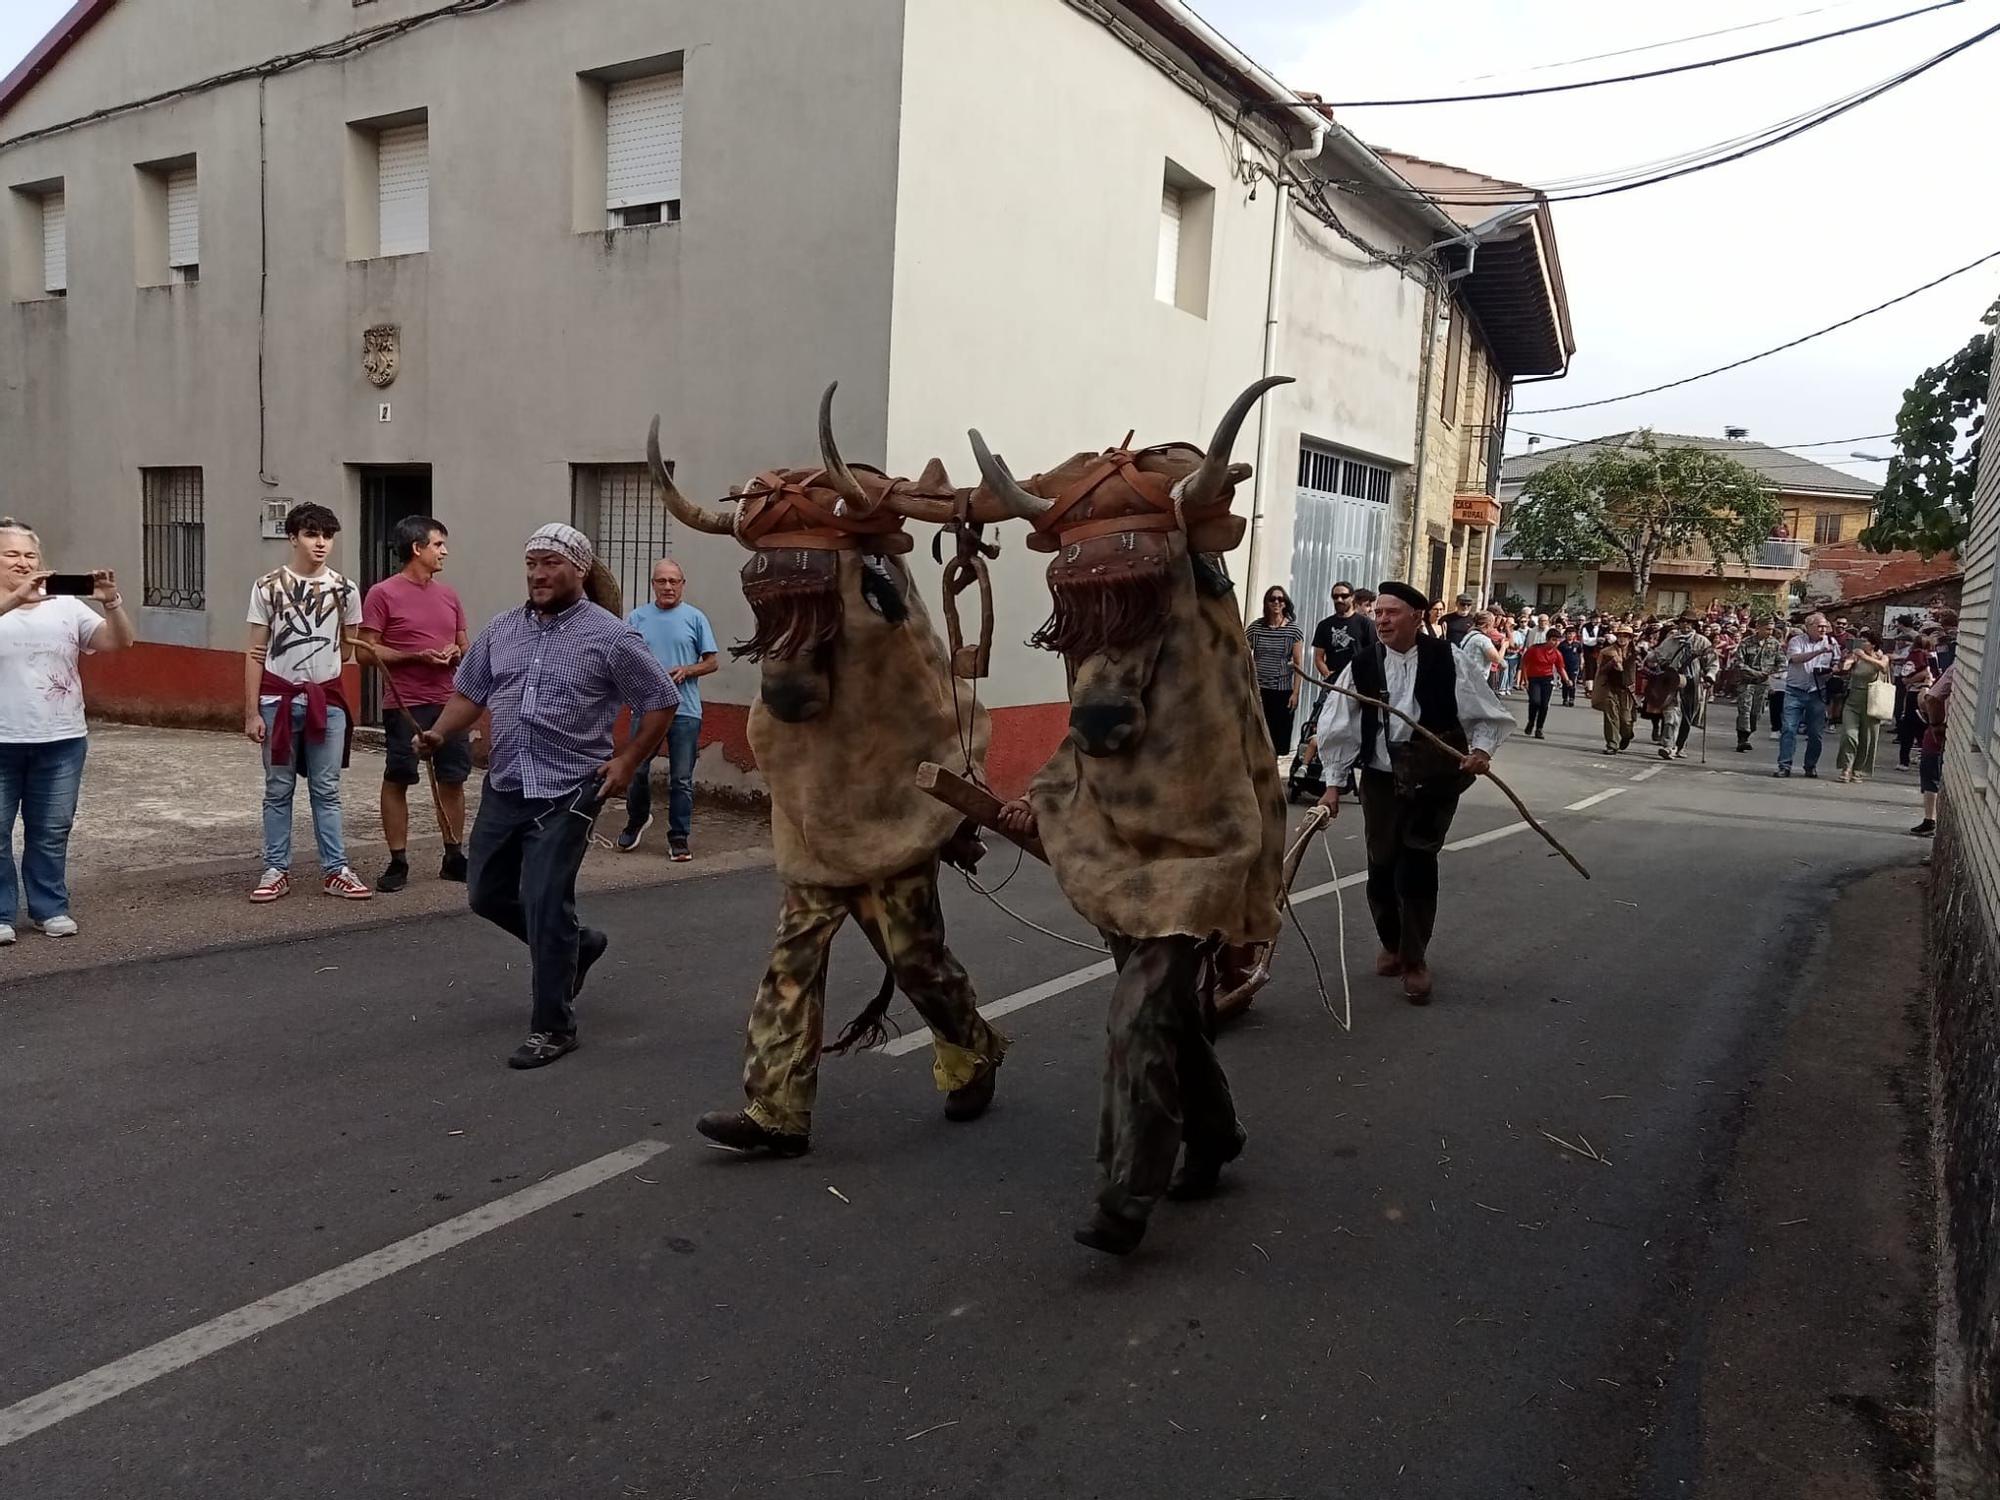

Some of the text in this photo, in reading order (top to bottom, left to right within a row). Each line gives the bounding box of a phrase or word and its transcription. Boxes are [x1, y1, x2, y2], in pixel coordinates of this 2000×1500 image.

[381, 406, 389, 419] 2
[1456, 501, 1472, 509] CASA
[1462, 511, 1483, 519] RURAL
